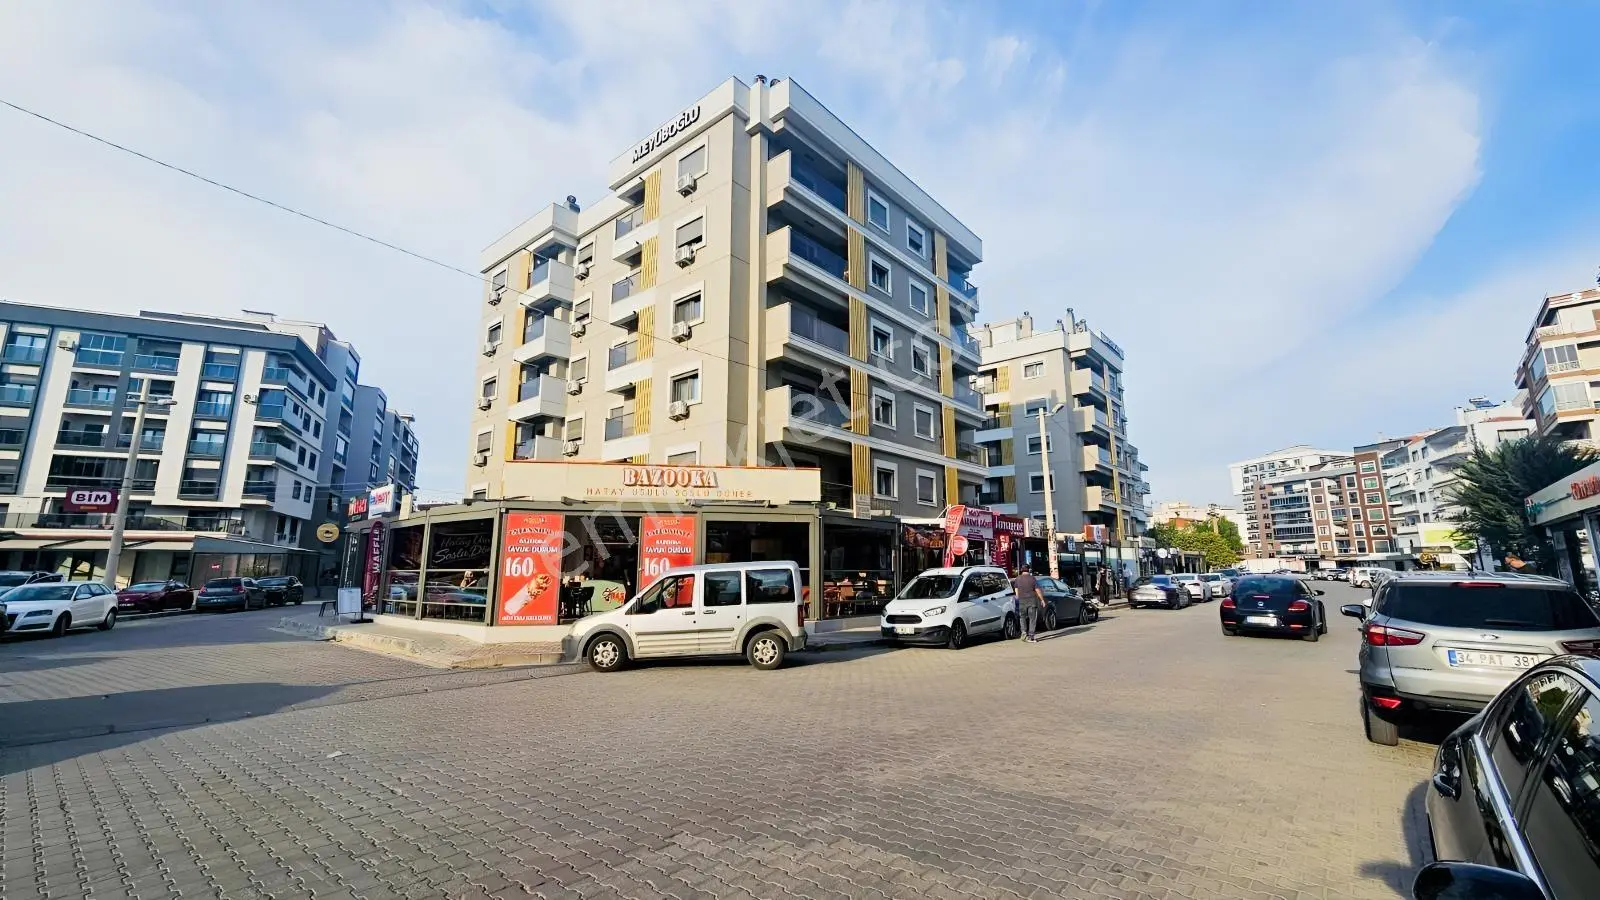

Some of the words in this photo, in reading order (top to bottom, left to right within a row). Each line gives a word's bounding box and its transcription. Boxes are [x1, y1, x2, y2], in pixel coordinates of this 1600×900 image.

[623, 468, 719, 487] BAZOOKA
[586, 487, 625, 497] HATAY
[504, 556, 534, 577] 160
[644, 557, 671, 577] 160
[1457, 652, 1474, 664] 34
